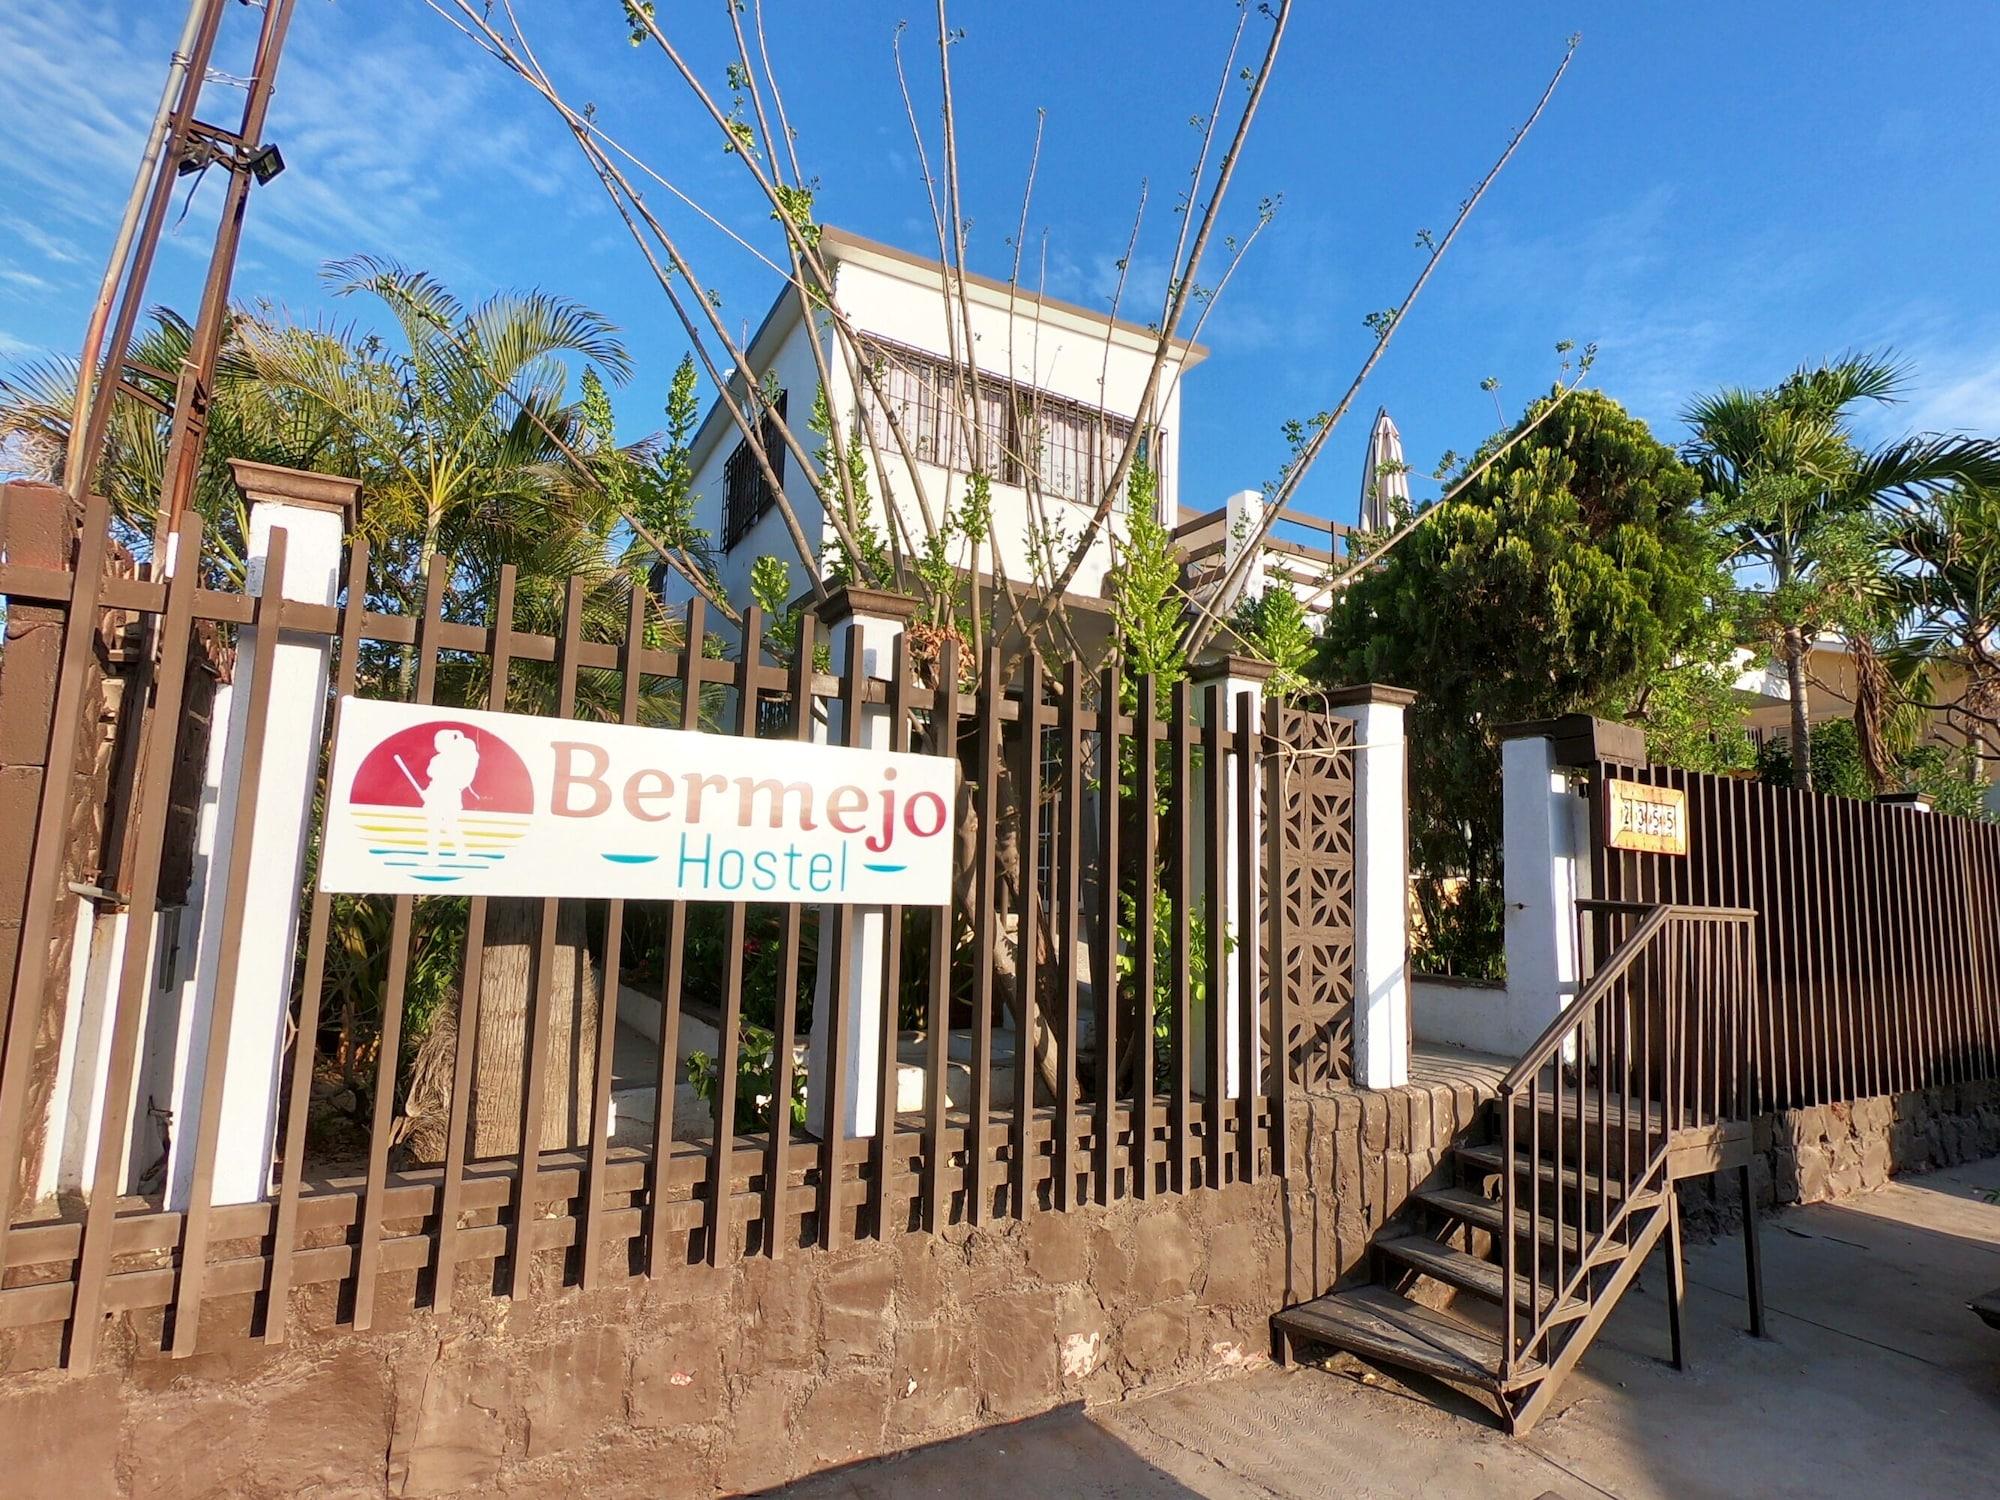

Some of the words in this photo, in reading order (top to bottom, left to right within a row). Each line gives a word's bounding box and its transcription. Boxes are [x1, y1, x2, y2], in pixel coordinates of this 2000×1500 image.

[551, 741, 947, 853] Bermejo
[1624, 805, 1674, 830] 2355
[678, 833, 847, 892] Hostel
